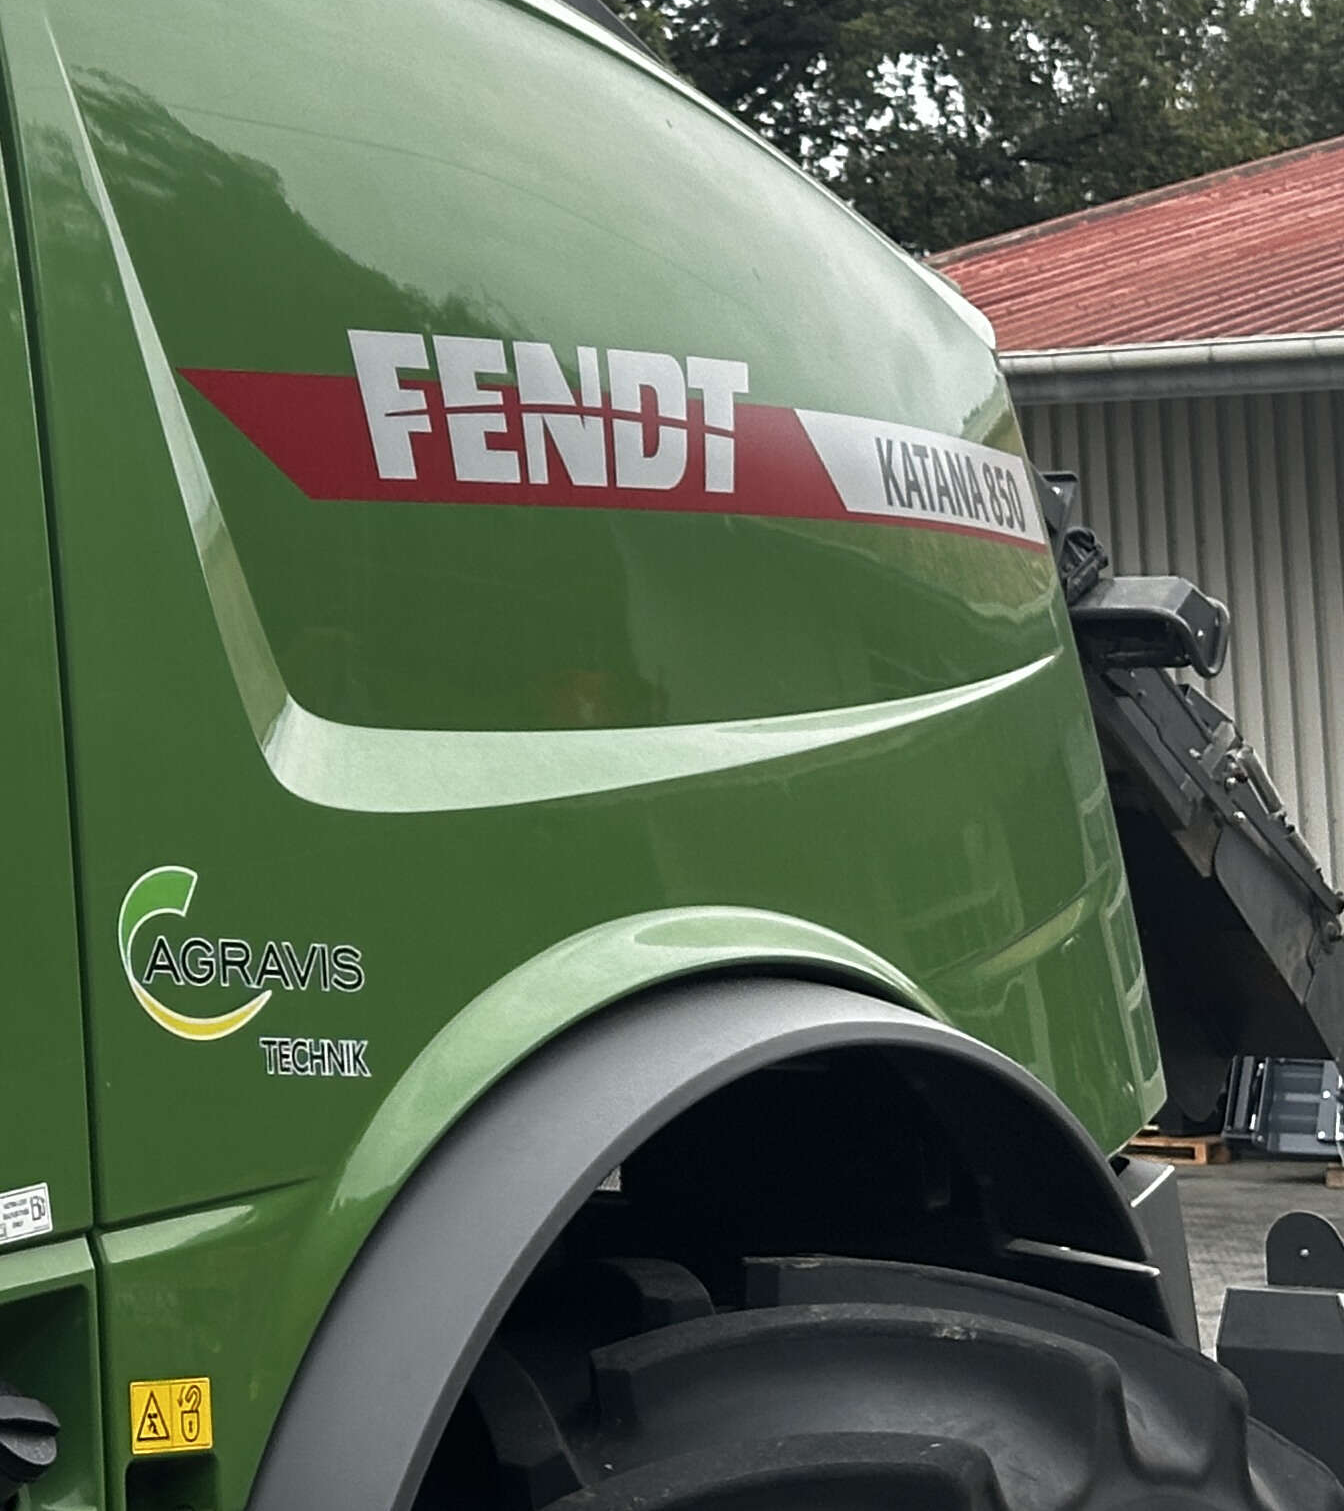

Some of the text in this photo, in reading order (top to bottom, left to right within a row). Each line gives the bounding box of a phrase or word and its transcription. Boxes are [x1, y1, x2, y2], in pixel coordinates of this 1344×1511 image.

[347, 329, 749, 493] FENDT
[875, 437, 1026, 533] KATANA 850
[143, 935, 365, 992] AGRAVIS
[259, 1037, 371, 1077] TECHNIK
